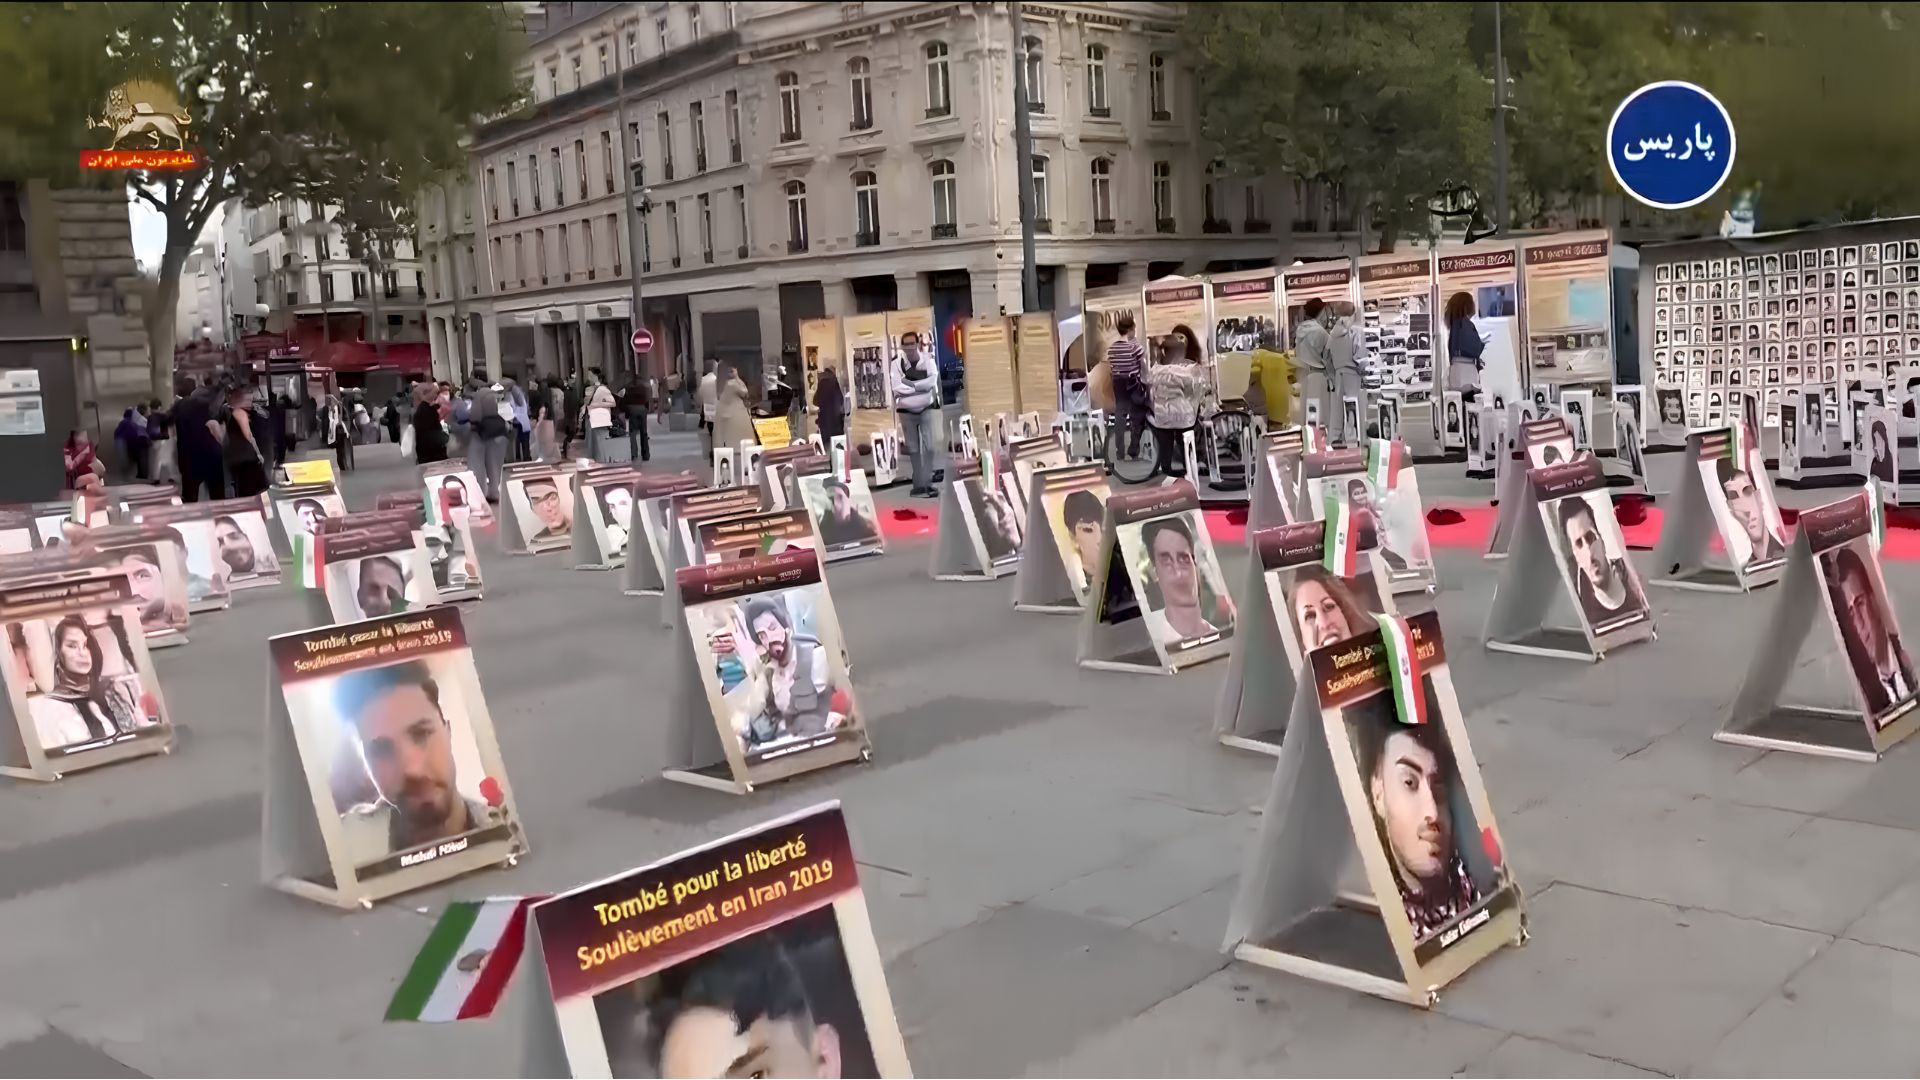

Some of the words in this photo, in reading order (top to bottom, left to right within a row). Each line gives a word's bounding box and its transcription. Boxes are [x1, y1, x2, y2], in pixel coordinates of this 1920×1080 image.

[577, 901, 718, 971] Soulèvement
[720, 897, 747, 918] en
[748, 877, 787, 907] Iran
[789, 859, 834, 892] 2019
[593, 881, 669, 926] Tombé
[672, 868, 720, 904] pour
[723, 861, 743, 883] la
[745, 834, 807, 875] liberté
